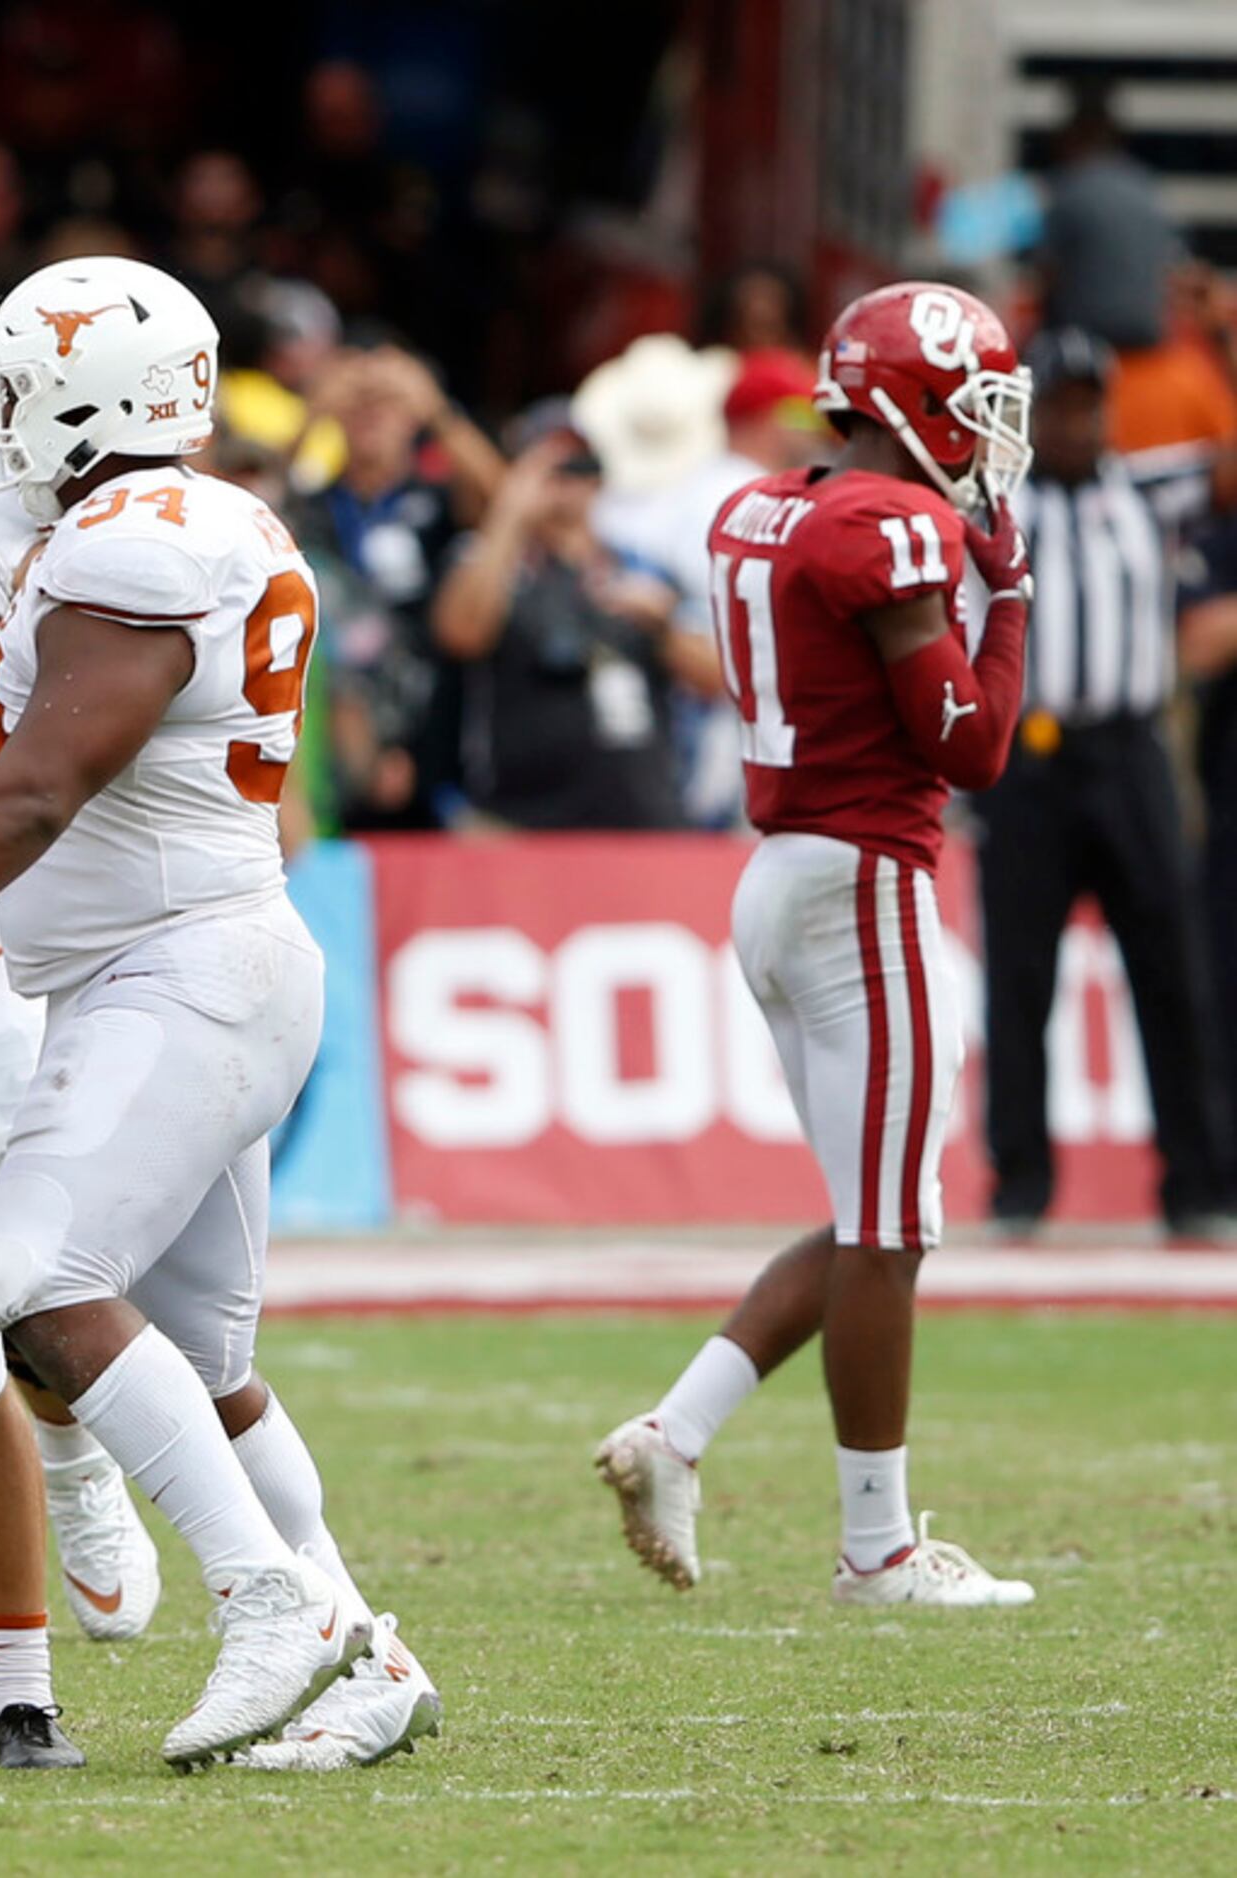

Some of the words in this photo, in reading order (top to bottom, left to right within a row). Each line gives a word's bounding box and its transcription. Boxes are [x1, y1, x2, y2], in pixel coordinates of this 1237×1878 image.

[911, 291, 975, 371] OU
[145, 398, 180, 424] XII
[192, 350, 211, 411] 9
[879, 513, 949, 589] 11
[712, 551, 797, 768] 11
